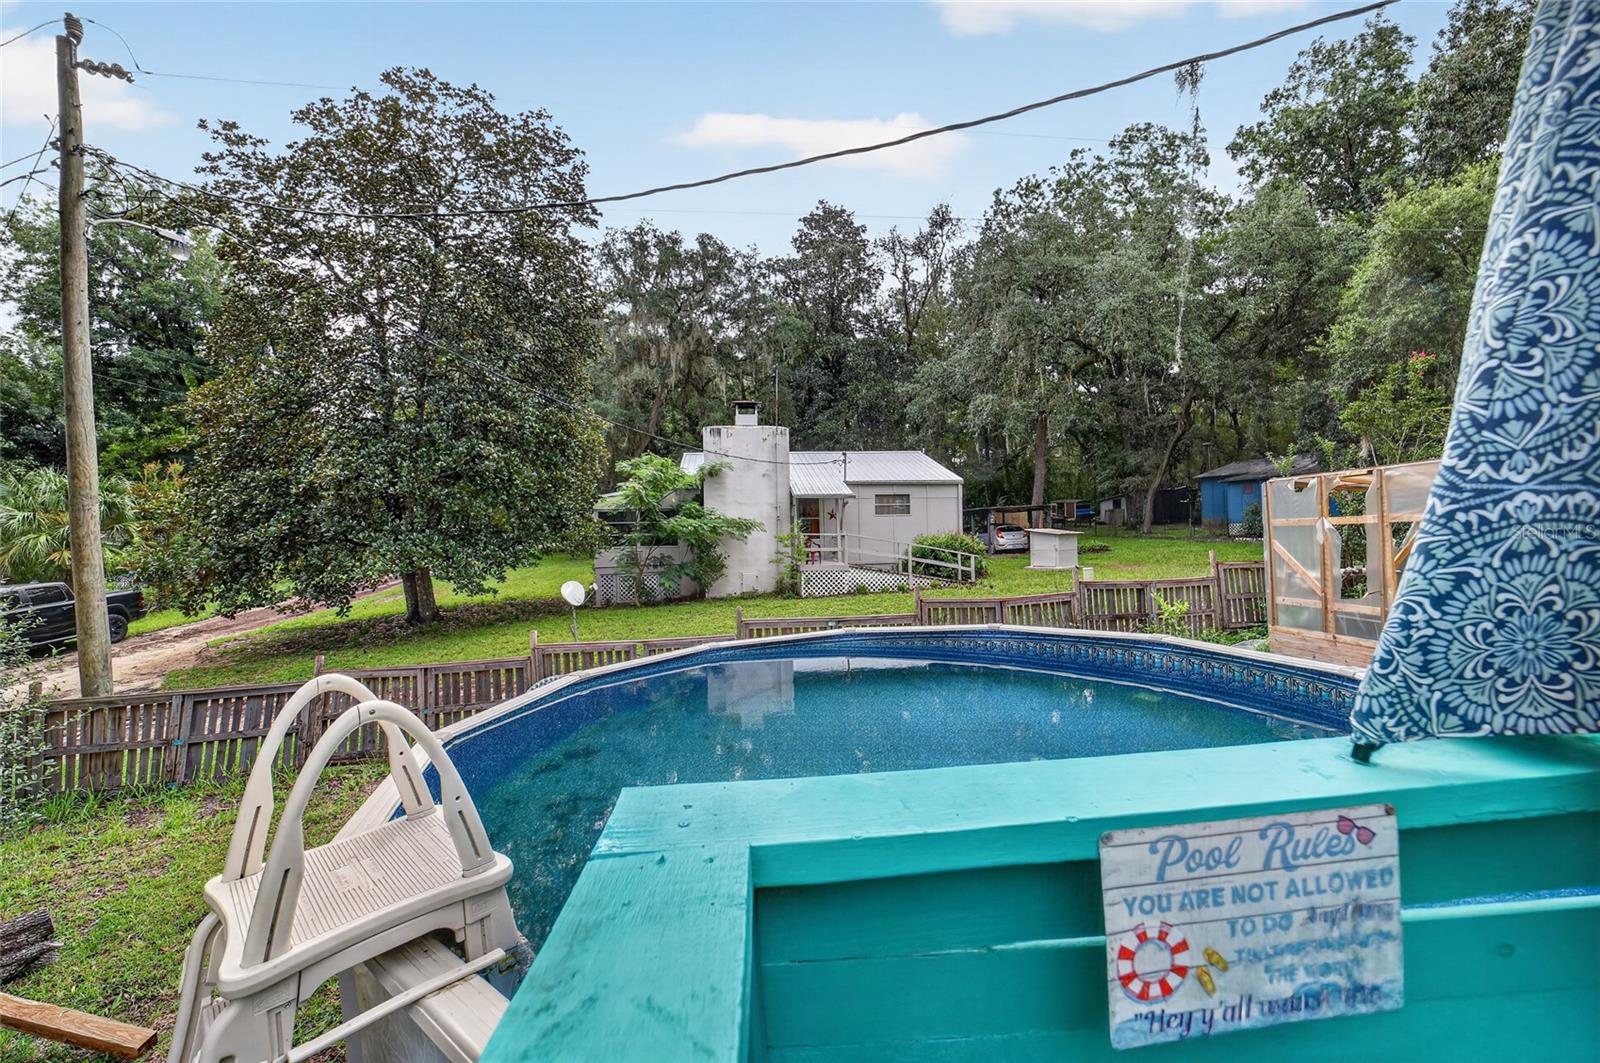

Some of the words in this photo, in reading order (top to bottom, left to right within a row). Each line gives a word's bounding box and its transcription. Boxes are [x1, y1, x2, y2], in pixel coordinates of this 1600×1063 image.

[1149, 834, 1243, 882] Pool
[1259, 822, 1356, 872] Rules
[1123, 894, 1173, 917] YOU
[1179, 886, 1225, 911] ARE
[1231, 880, 1279, 905] NOT
[1285, 865, 1394, 900] ALLOWED
[1227, 918, 1256, 938] TO
[1262, 911, 1294, 933] DO
